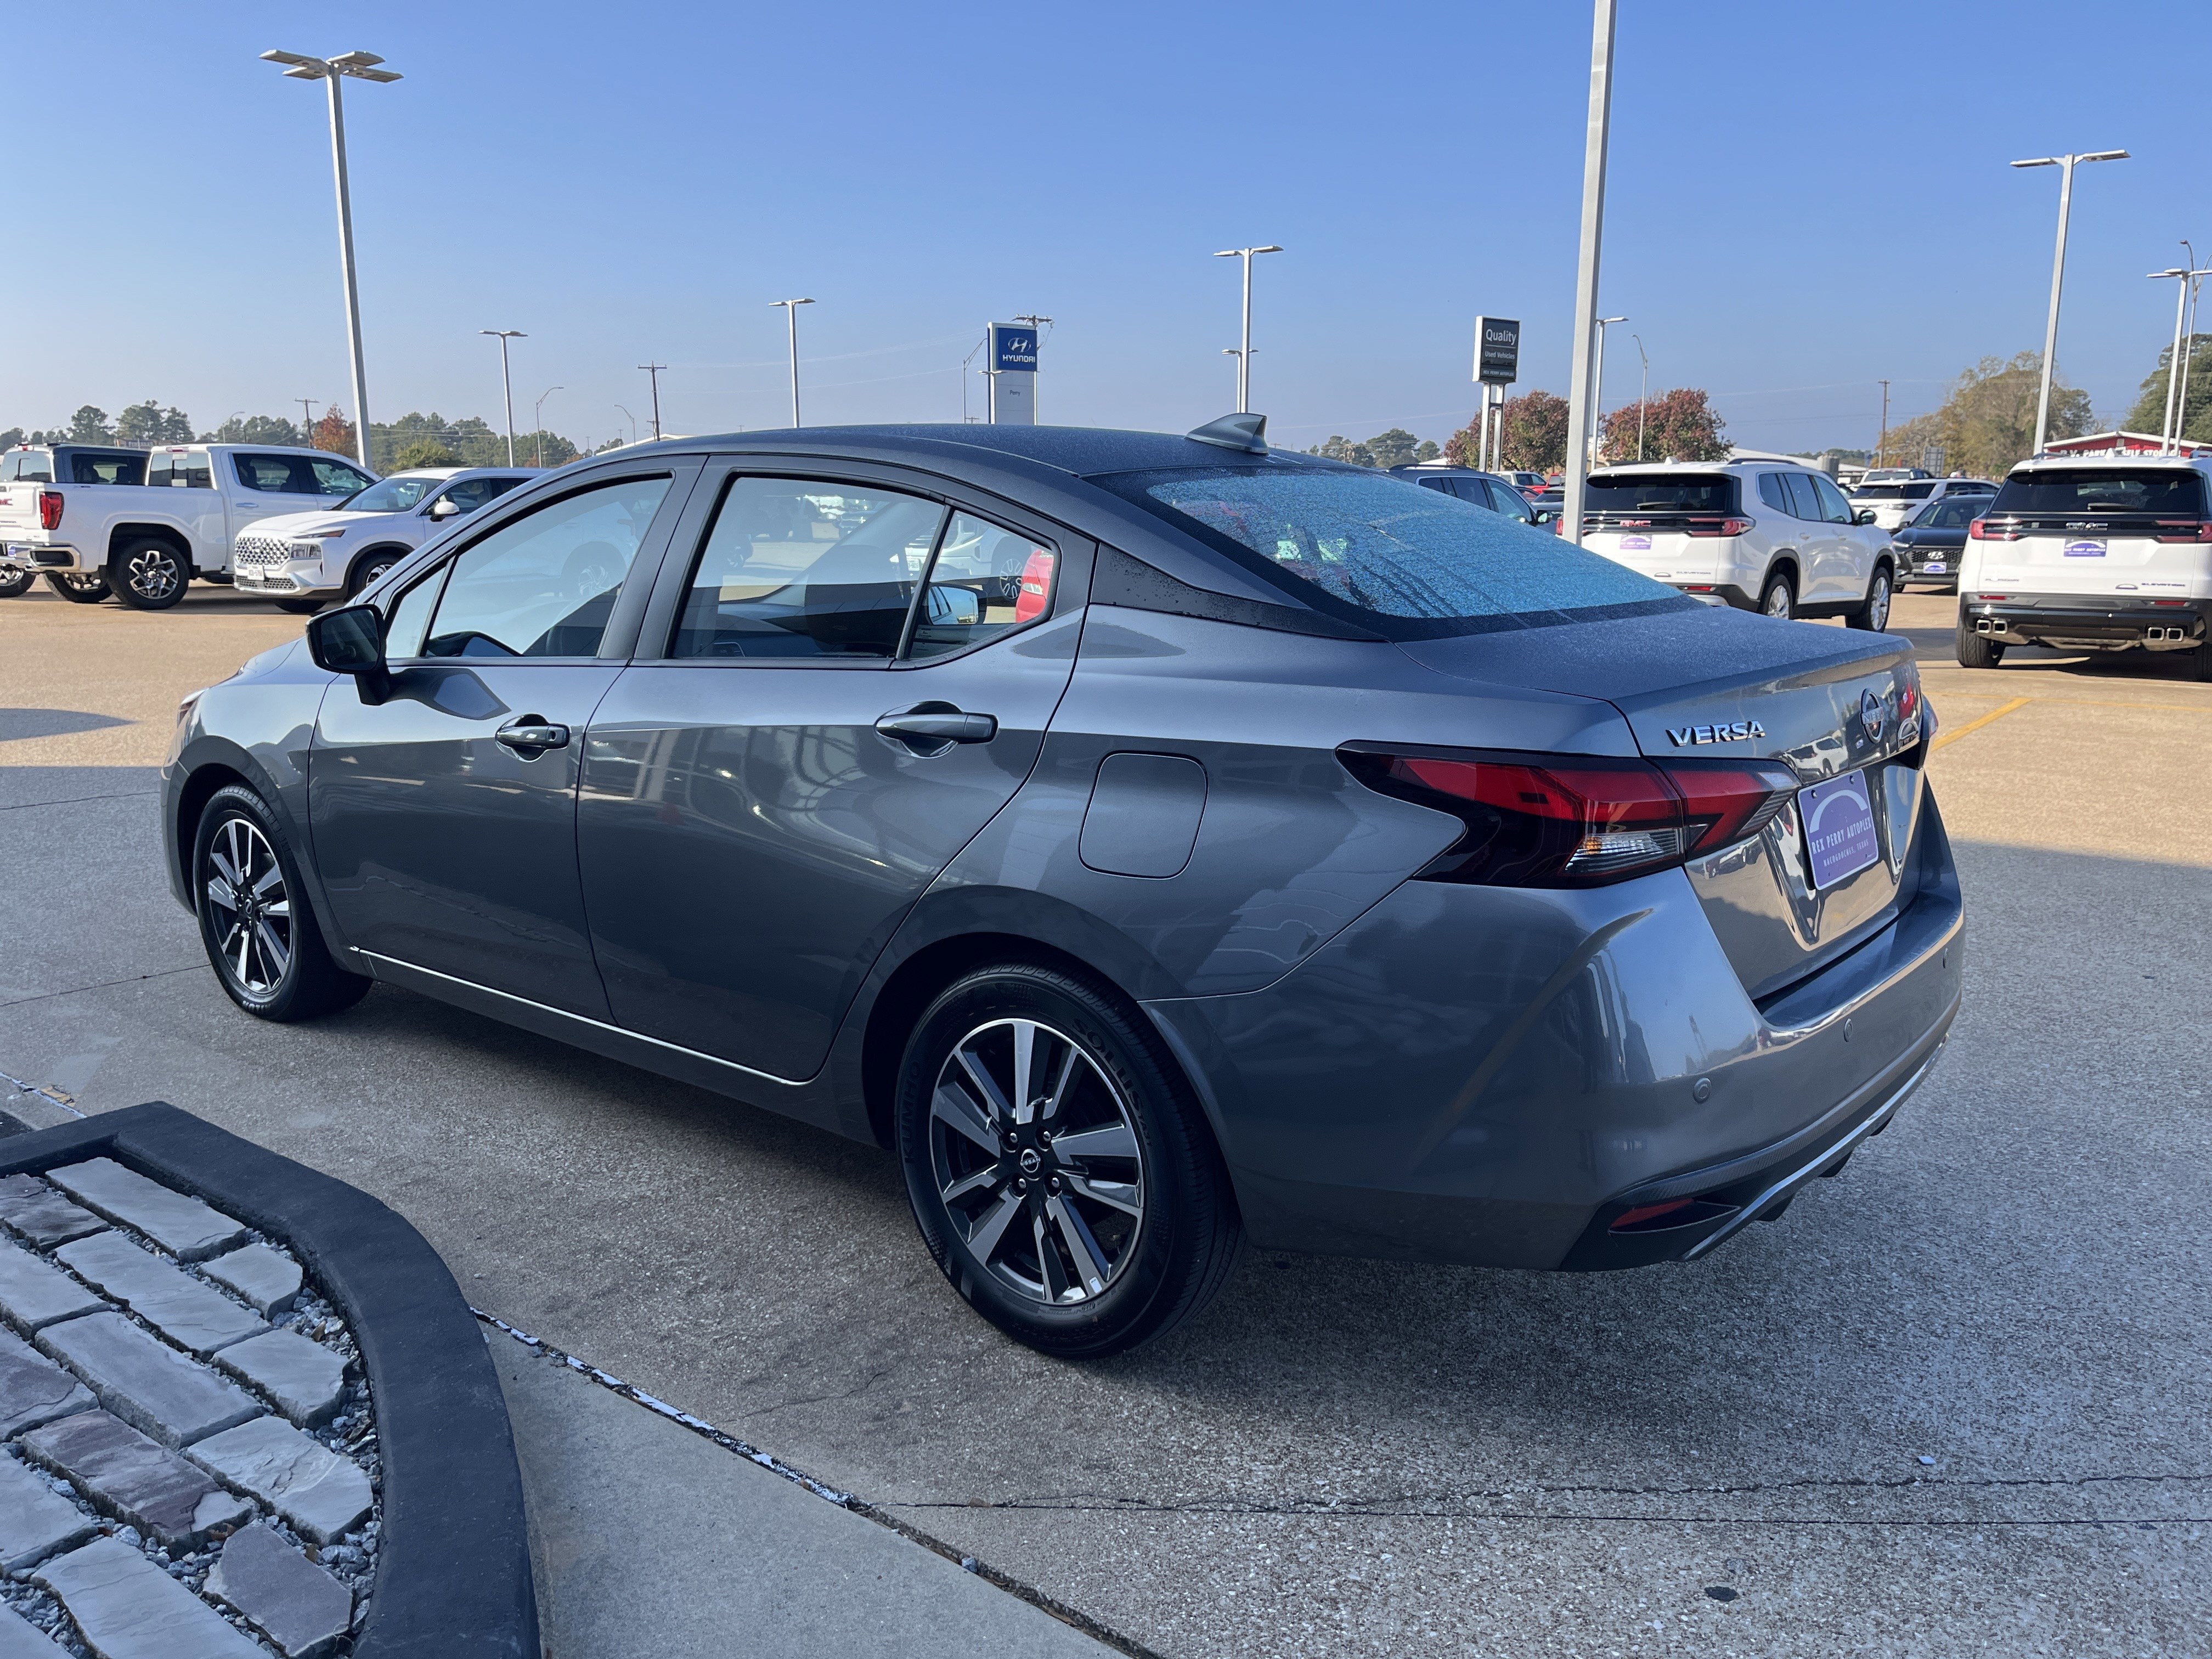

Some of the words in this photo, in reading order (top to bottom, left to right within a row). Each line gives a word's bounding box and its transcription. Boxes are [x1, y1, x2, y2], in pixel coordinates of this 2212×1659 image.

[1486, 329, 1516, 345] Quality
[1002, 354, 1036, 363] HYUNDAI
[1666, 720, 1765, 747] VERSA
[1812, 838, 1825, 854] REX
[1826, 829, 1844, 848] PERRY
[1847, 816, 1871, 839] AUTOPLEX
[1857, 839, 1869, 850] TEXAS
[1072, 1018, 1143, 1111] SOLUS
[1020, 1155, 1041, 1166] NISSAN
